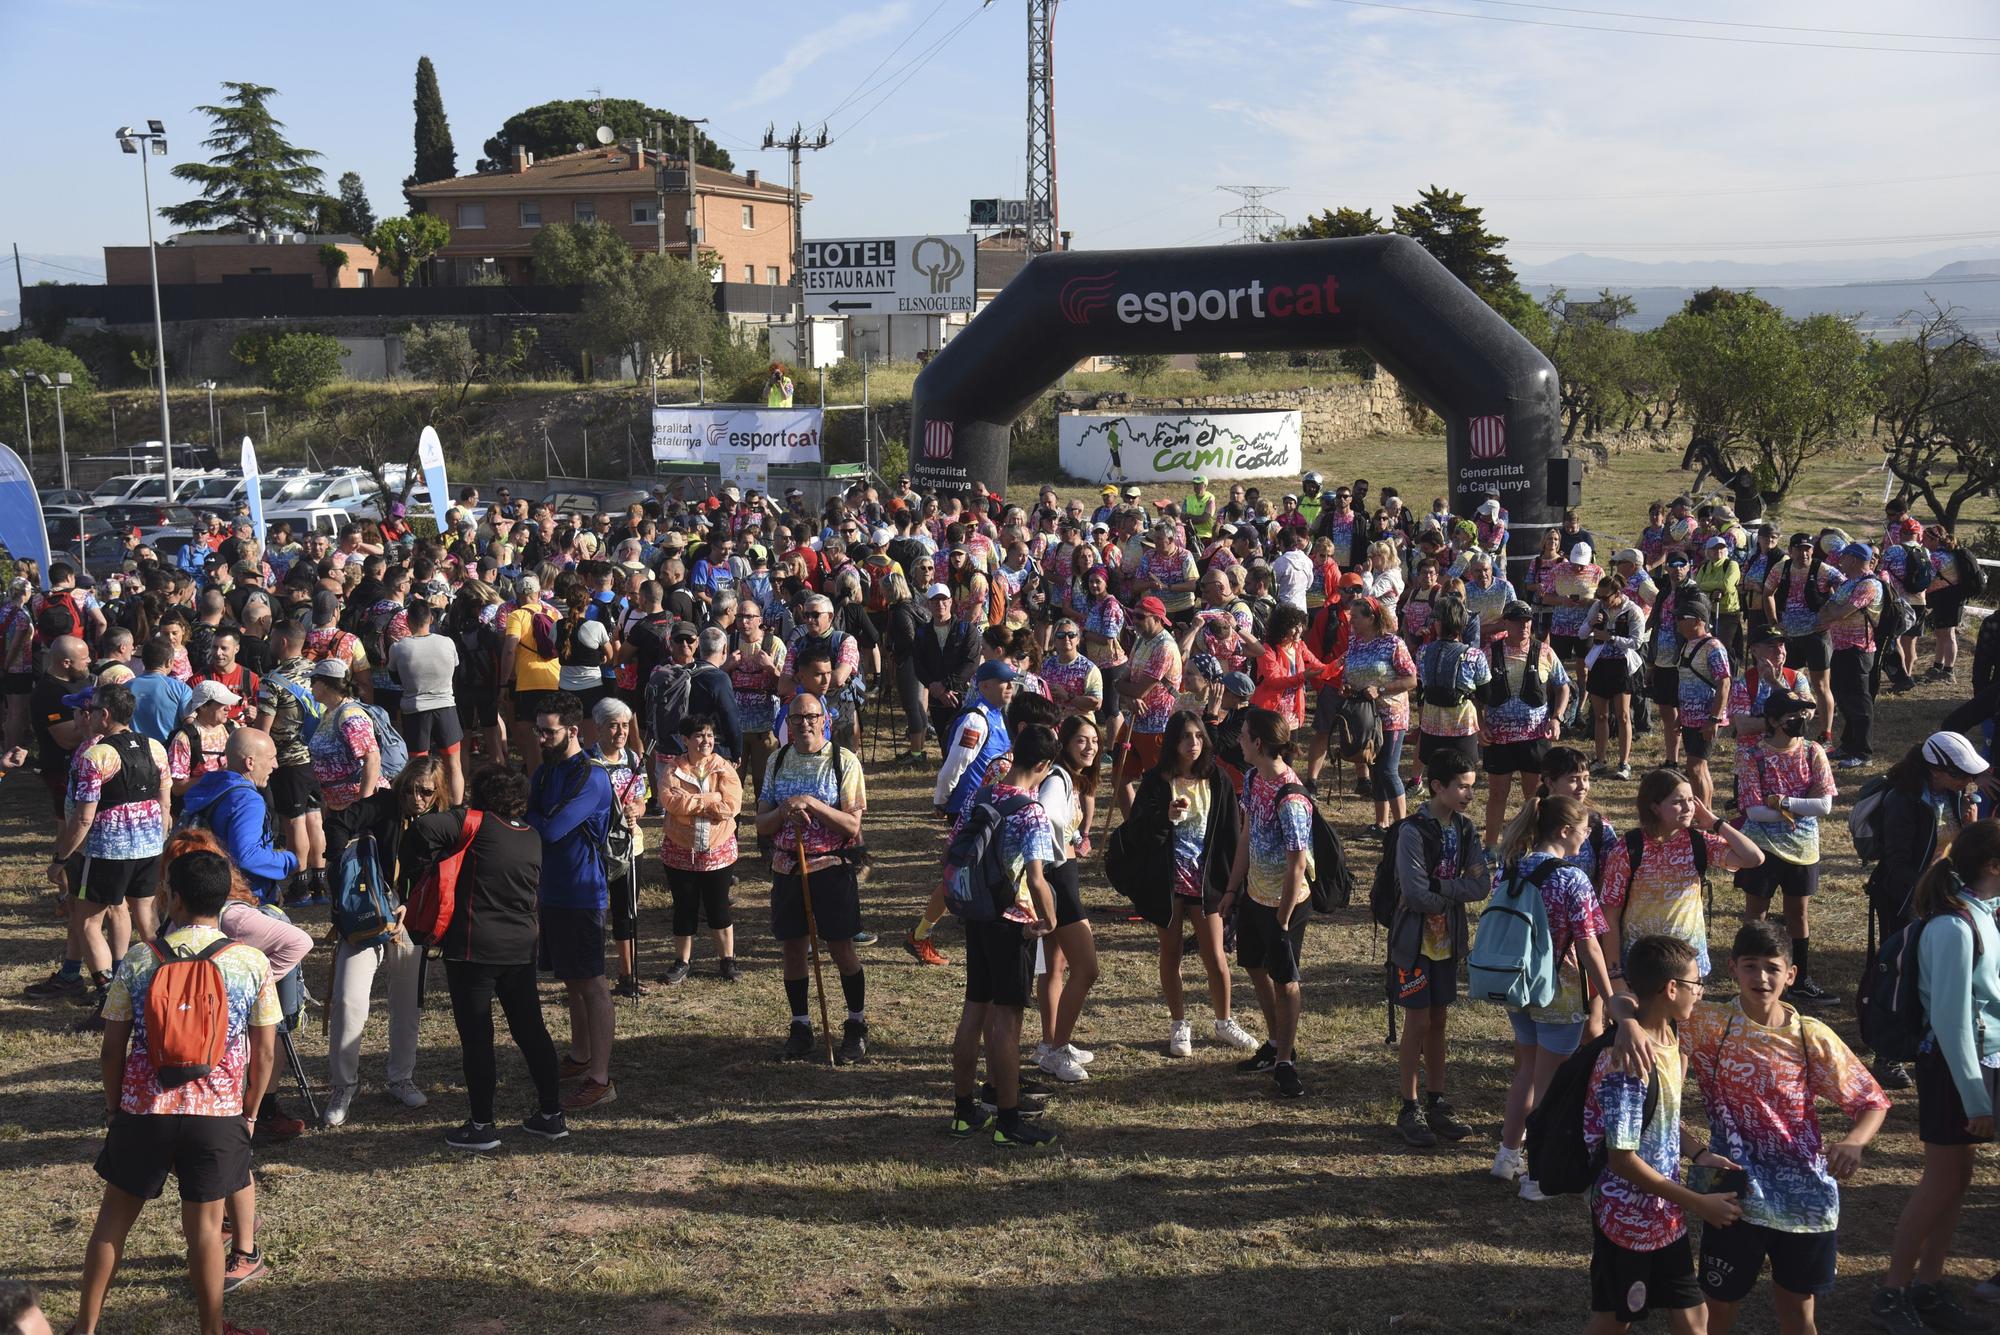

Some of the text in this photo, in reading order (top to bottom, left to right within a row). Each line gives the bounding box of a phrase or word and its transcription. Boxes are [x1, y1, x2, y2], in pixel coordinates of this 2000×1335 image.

[1000, 202, 1049, 220] HOTEL
[803, 242, 894, 267] HOTEL
[801, 269, 896, 289] RESTAURANT
[1116, 275, 1341, 331] esportcat
[729, 428, 819, 451] esportcat
[1234, 444, 1289, 470] costat
[914, 463, 967, 477] Generalitat
[1460, 464, 1524, 479] Generalitat
[911, 475, 972, 491] de Catalunya
[1457, 479, 1531, 493] de Catalunya
